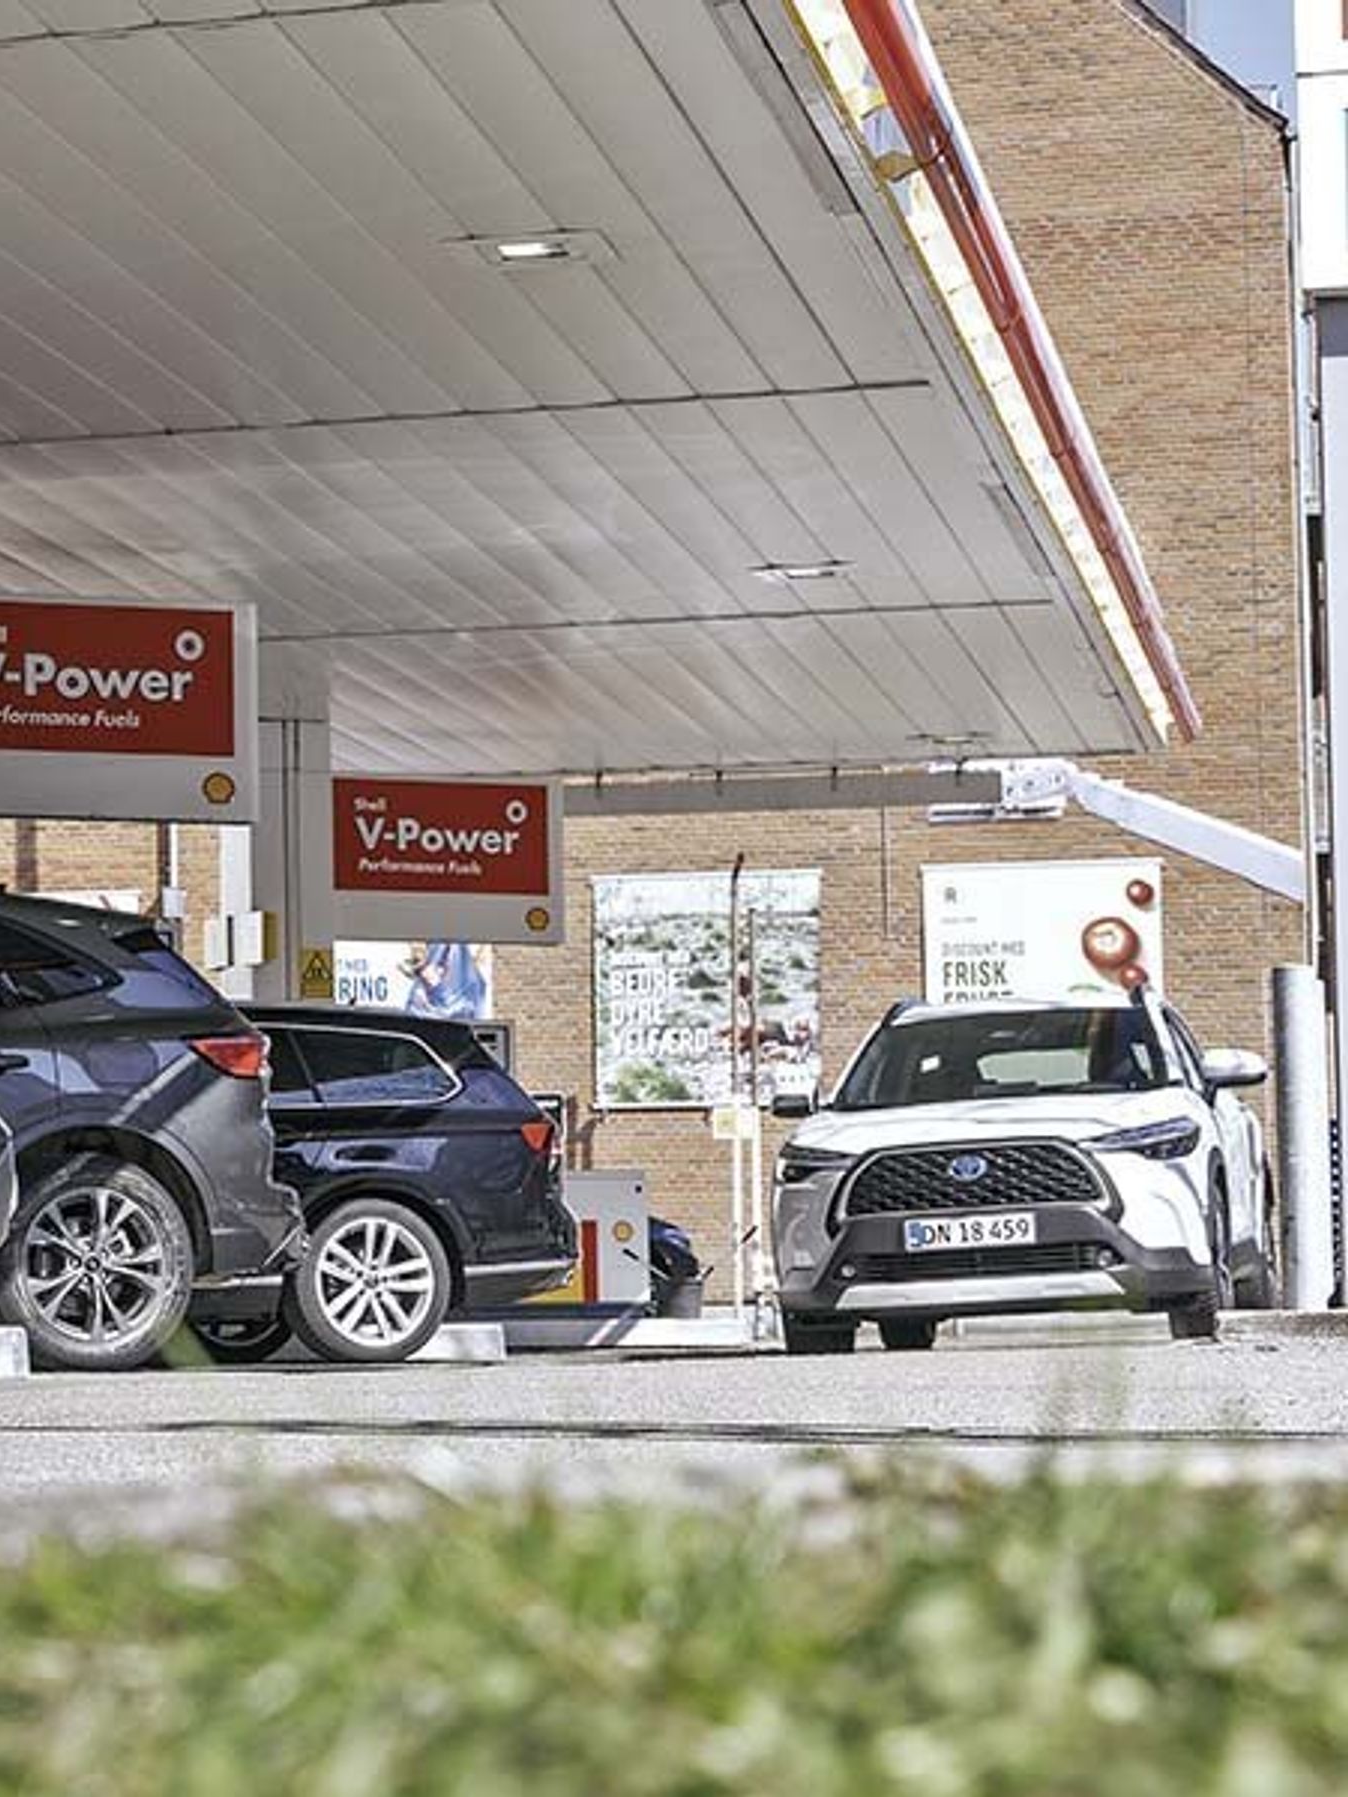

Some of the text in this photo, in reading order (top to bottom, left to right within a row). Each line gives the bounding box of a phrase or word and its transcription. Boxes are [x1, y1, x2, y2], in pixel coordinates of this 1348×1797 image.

[94, 709, 140, 728] Fuels
[354, 797, 387, 812] Shell
[355, 817, 519, 854] V-Power
[358, 857, 482, 876] Performance Fuels
[943, 960, 1008, 987] FRISK
[959, 1221, 984, 1241] 18
[989, 1218, 1029, 1240] 459
